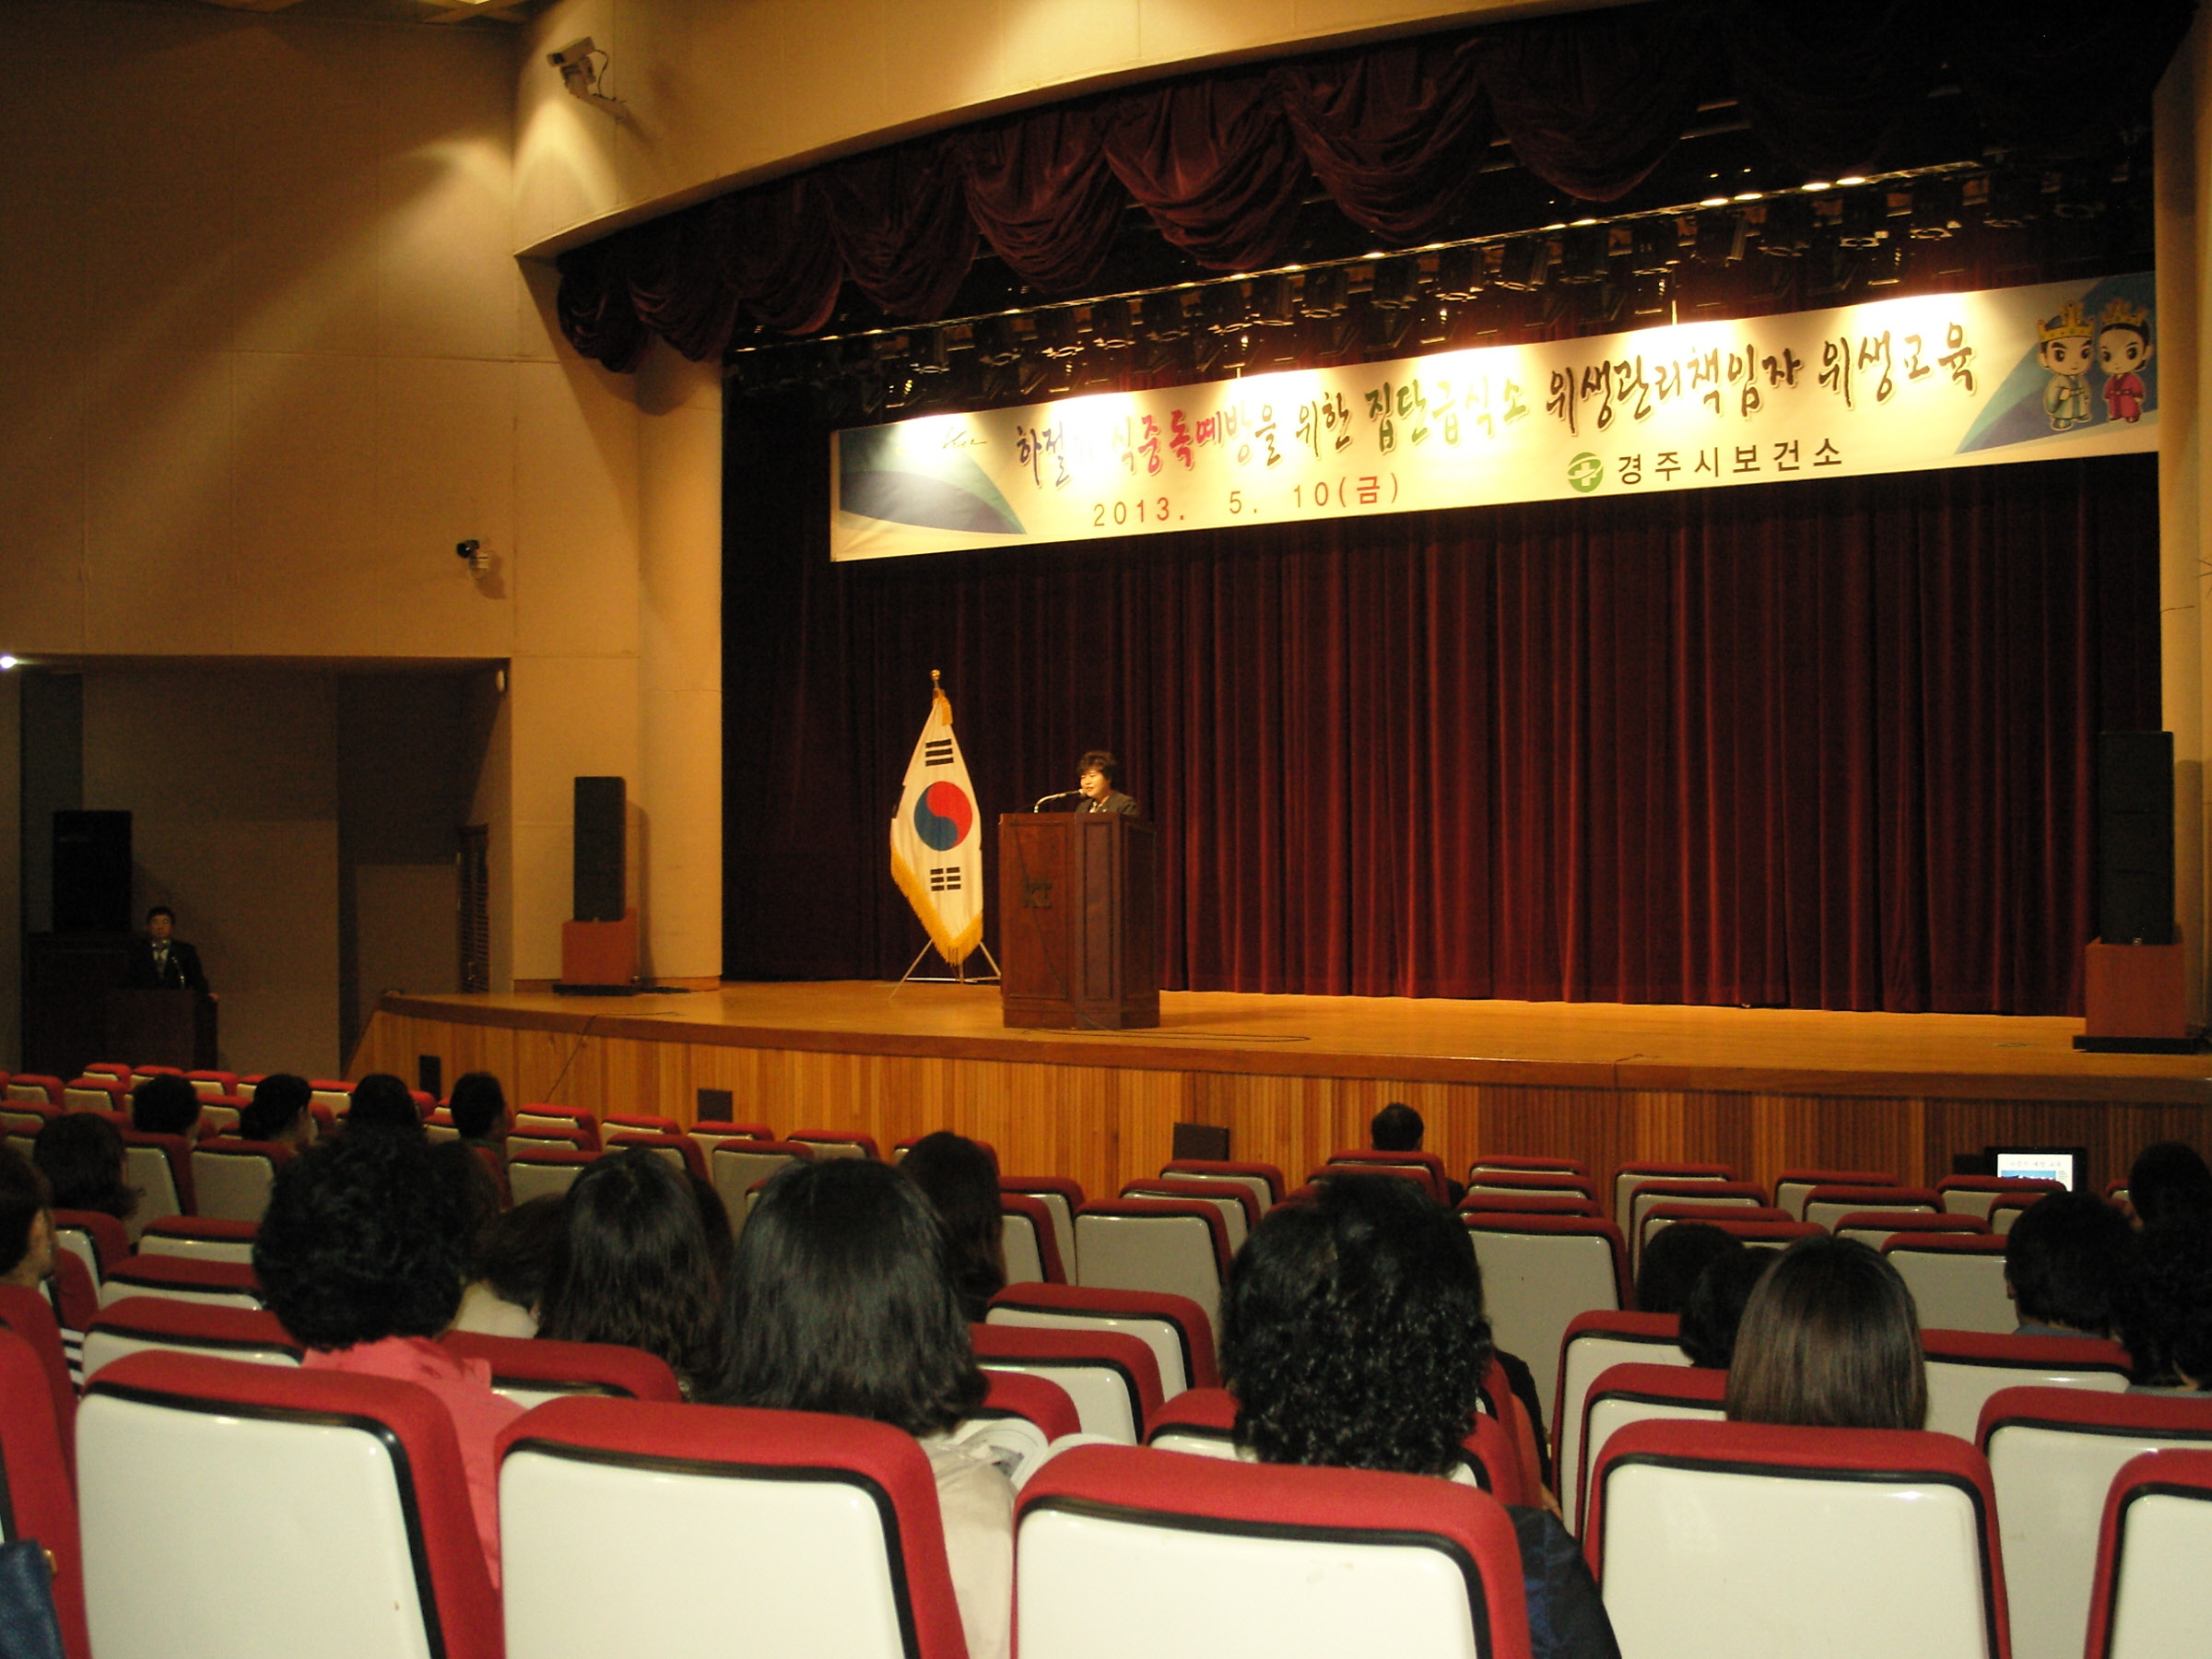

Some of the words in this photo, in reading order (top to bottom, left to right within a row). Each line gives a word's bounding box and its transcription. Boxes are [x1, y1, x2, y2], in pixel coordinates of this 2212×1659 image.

[1016, 421, 1094, 487] 하절
[1295, 392, 1349, 458] 위한
[1364, 377, 1526, 453] 집단급식소
[1546, 342, 1802, 434] 위생관리책임자
[1818, 322, 1972, 407] 위생교육
[1617, 437, 1843, 486] 경주시보건소
[1093, 496, 1185, 527] 2013.
[1229, 489, 1258, 514] 5.
[1292, 472, 1399, 509] 10(금)
